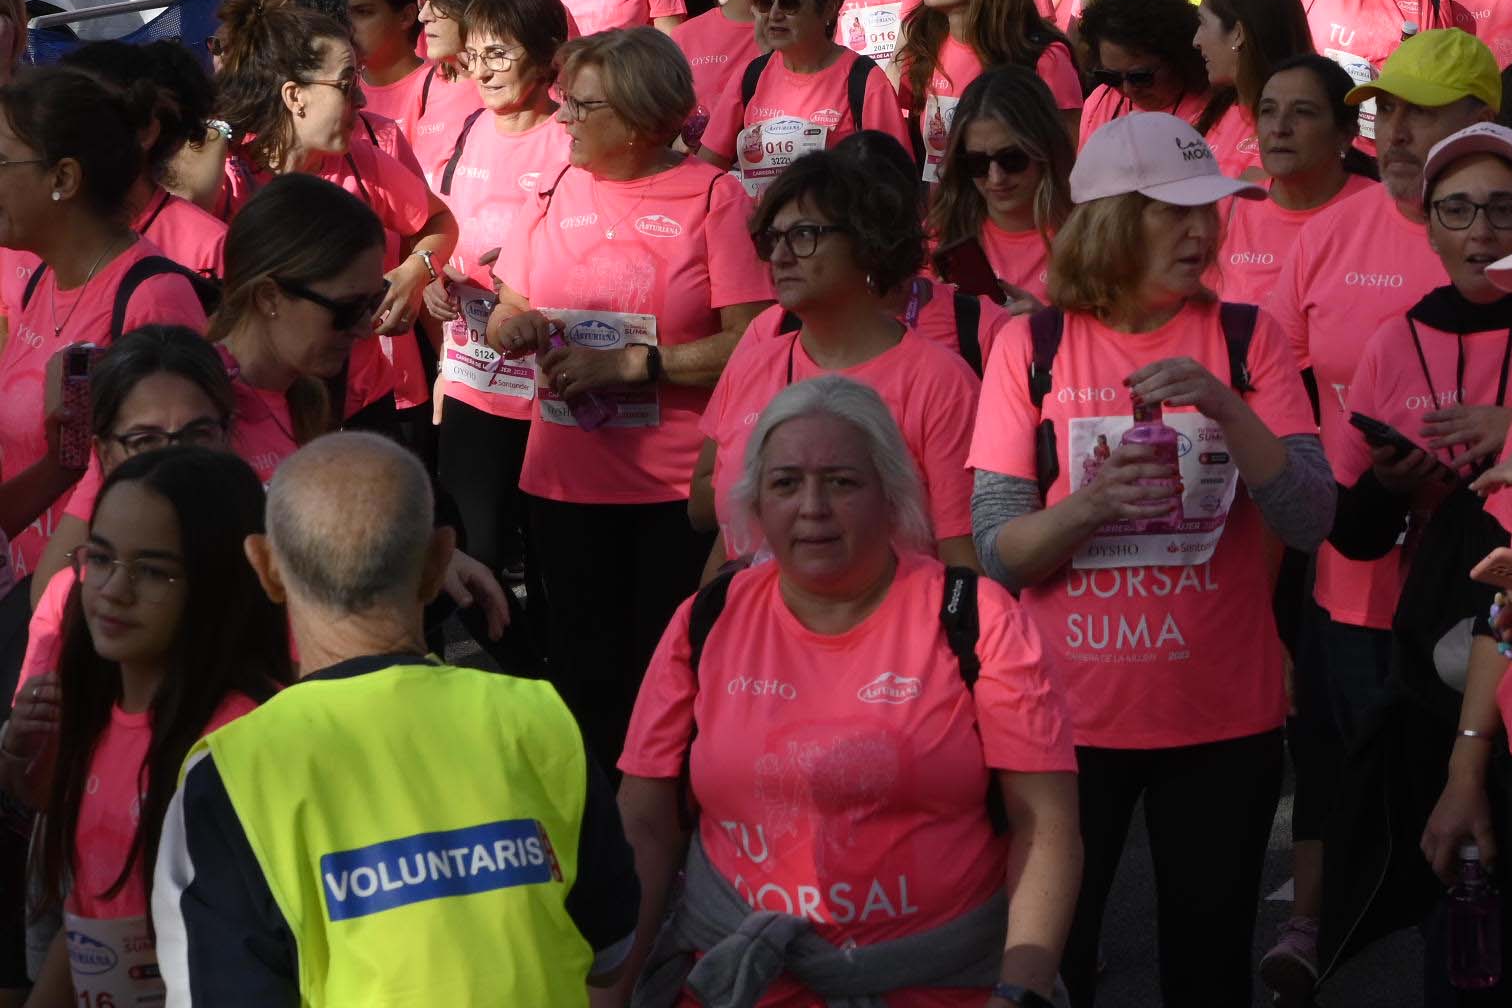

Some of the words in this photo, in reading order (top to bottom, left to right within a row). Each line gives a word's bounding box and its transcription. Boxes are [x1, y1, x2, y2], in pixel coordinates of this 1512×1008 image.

[1456, 9, 1491, 22] OYSHO
[870, 31, 896, 43] 016
[1328, 23, 1356, 47] TU
[873, 43, 894, 52] 20479
[690, 55, 729, 66] OYSHO
[765, 141, 794, 154] 016
[559, 212, 599, 231] OYSHO
[639, 220, 680, 235] ASTURIANA
[1344, 271, 1404, 289] OYSHO
[573, 330, 616, 342] ASTURIANA
[624, 328, 648, 336] SUMA
[474, 348, 496, 361] 6124
[453, 366, 477, 380] OYSHO
[498, 380, 529, 391] Santander
[1057, 387, 1116, 404] OYSHO
[1088, 544, 1139, 557] OYSHO
[1067, 564, 1218, 598] DORSAL
[1066, 611, 1185, 650] SUMA
[727, 675, 797, 700] OYSHO
[864, 683, 919, 699] ASTURIANA
[720, 821, 769, 864] TU
[324, 834, 545, 903] VOLUNTARIS
